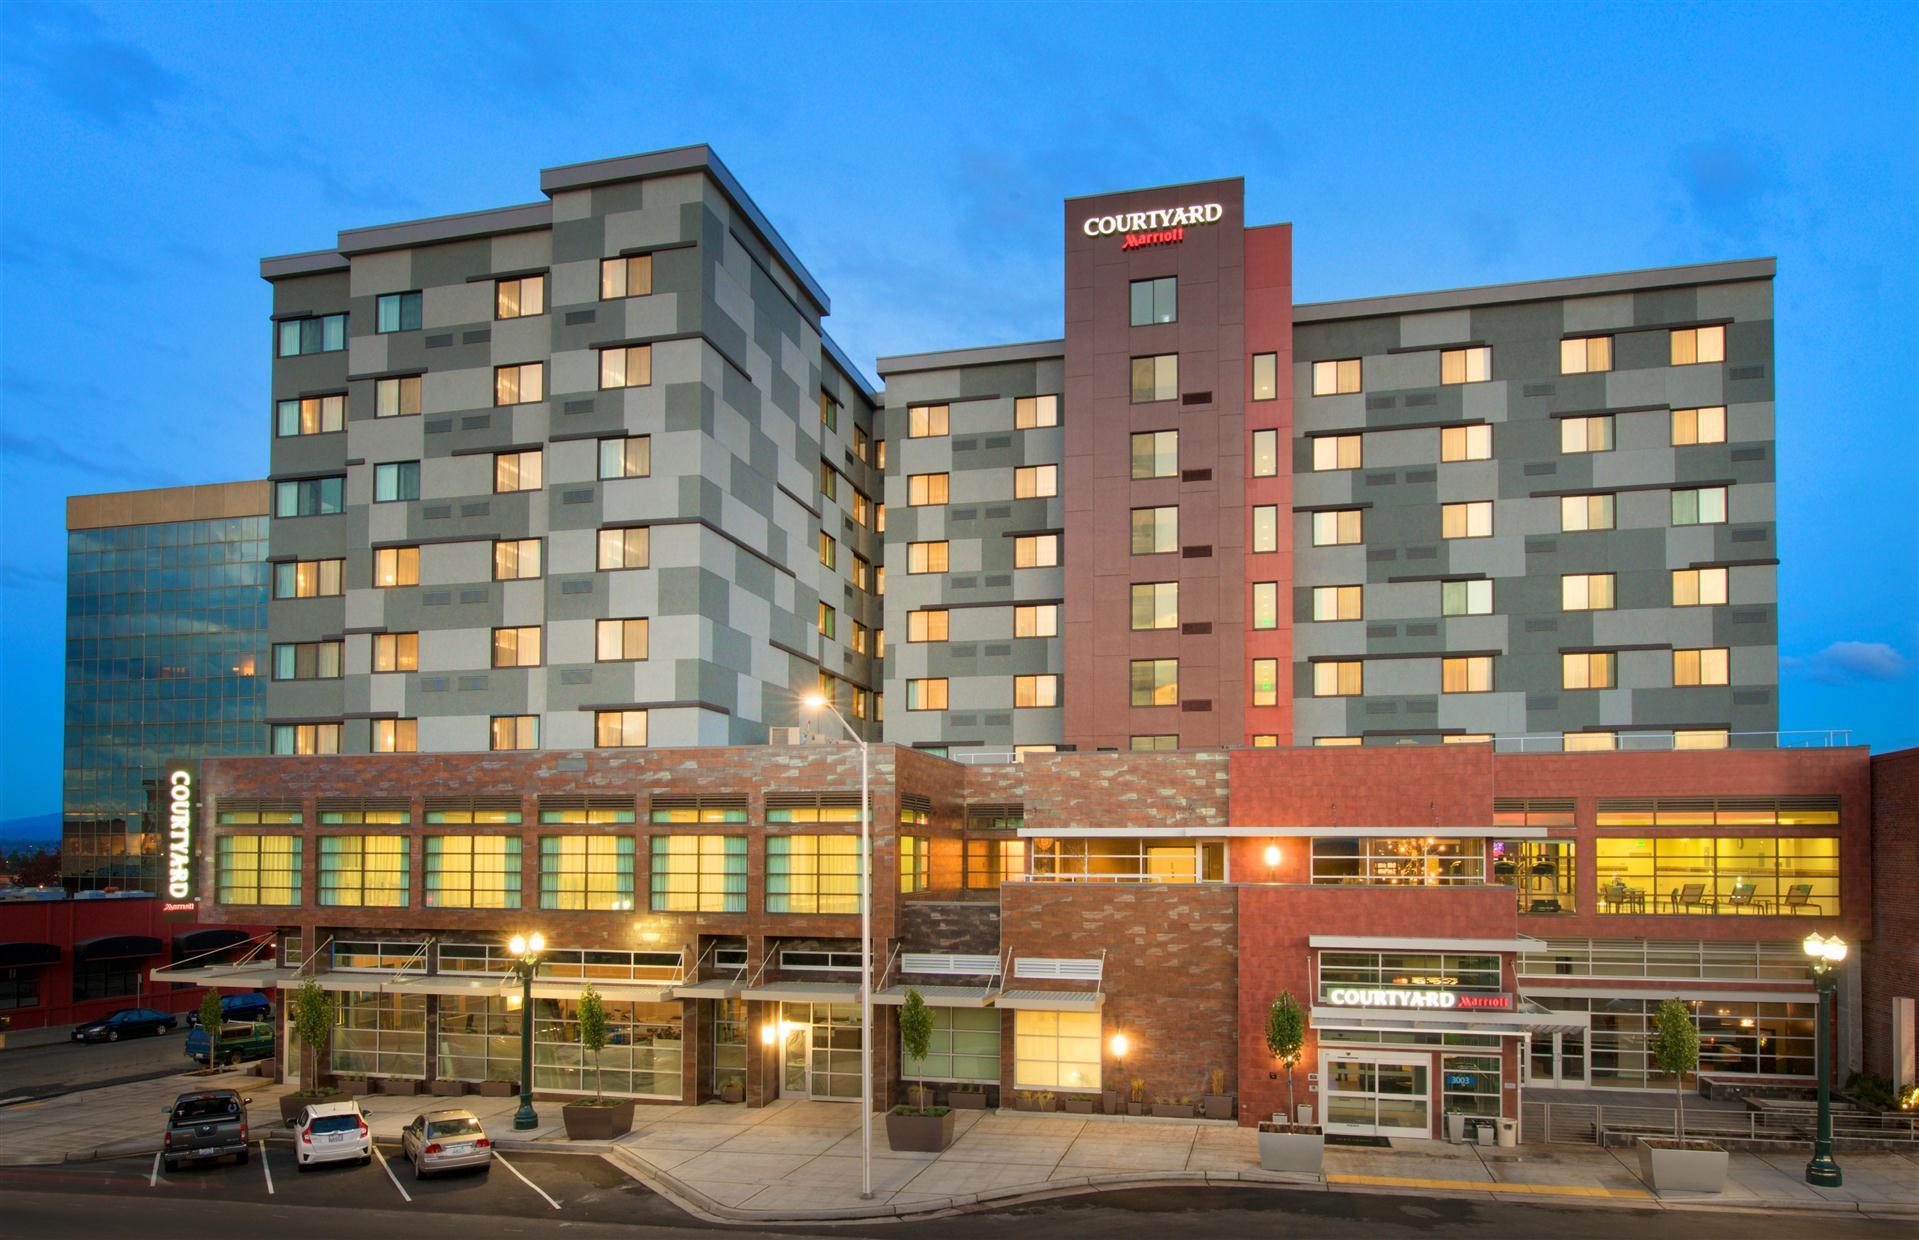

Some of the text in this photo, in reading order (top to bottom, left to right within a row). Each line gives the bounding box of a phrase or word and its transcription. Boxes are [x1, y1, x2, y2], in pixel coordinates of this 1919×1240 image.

[1083, 202, 1223, 237] COURTYARD
[1121, 226, 1184, 250] Marriott
[170, 770, 191, 898] COURTYARD
[1330, 988, 1509, 1008] COURTYARD Marriott
[1451, 1075, 1470, 1085] 3003
